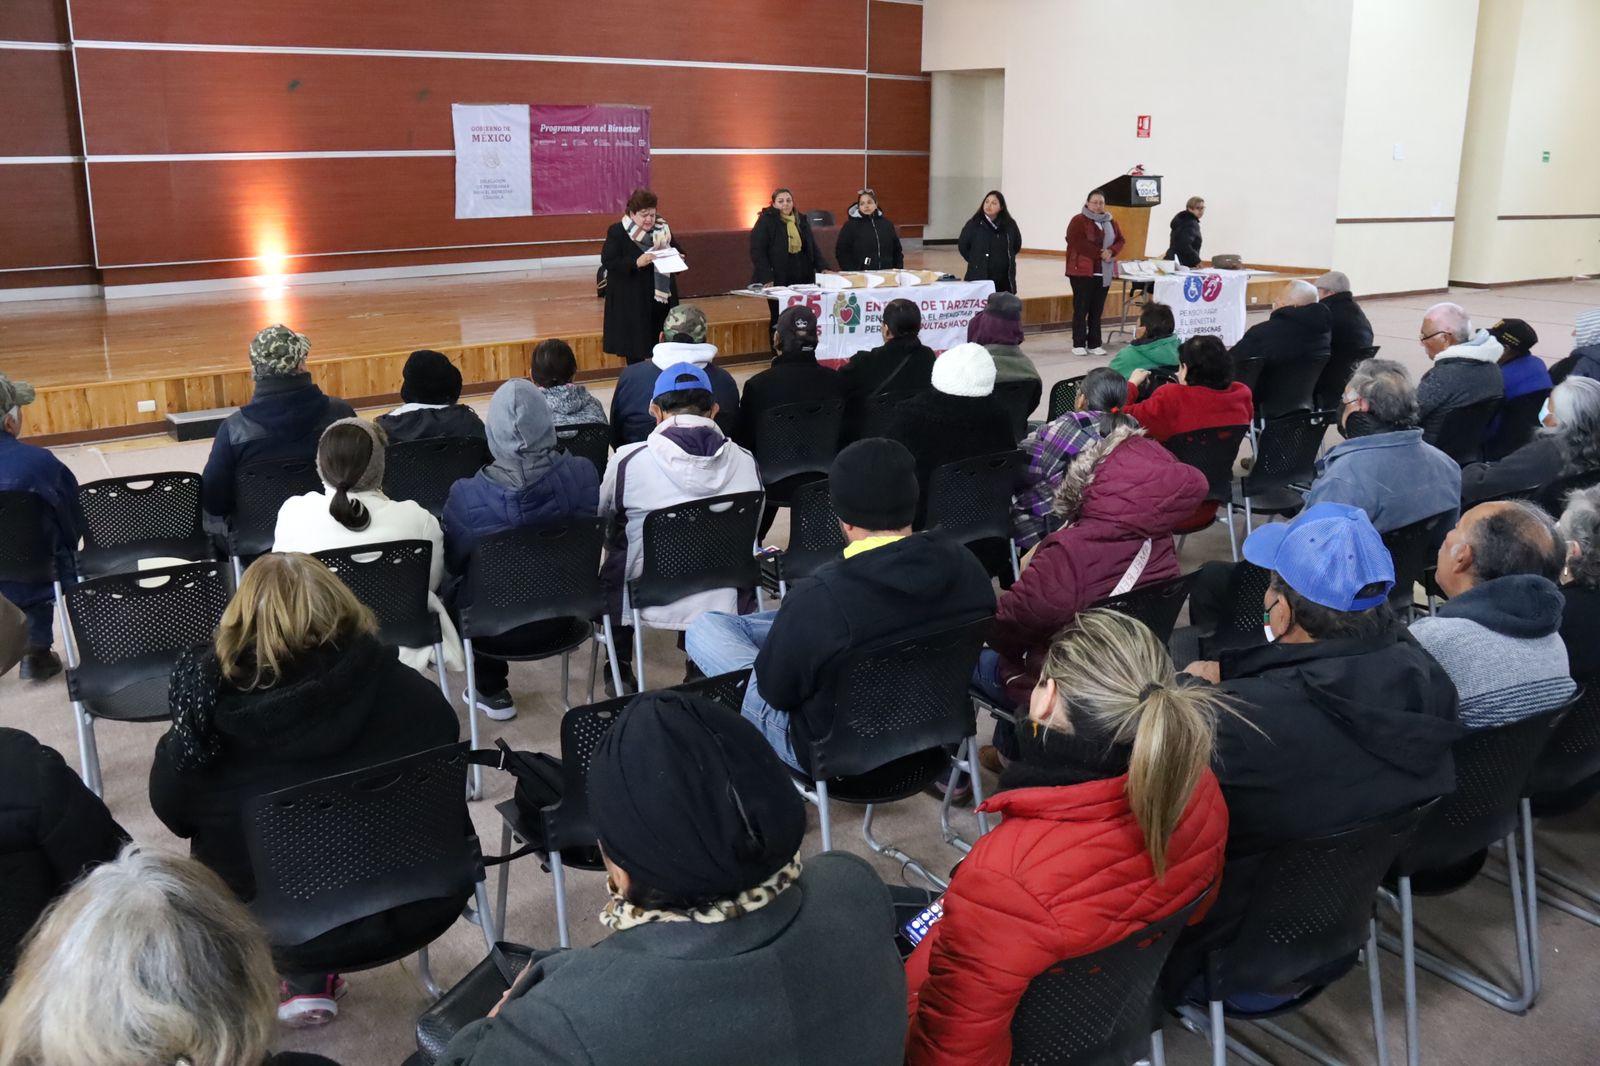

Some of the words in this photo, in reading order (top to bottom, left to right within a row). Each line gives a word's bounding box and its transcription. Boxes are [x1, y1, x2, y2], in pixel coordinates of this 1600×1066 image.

[540, 123, 581, 134] Programas
[581, 124, 599, 134] para
[600, 124, 607, 133] el
[608, 123, 641, 133] Bienestar
[921, 300, 937, 311] DE
[939, 298, 988, 311] TARJETAS
[928, 313, 938, 321] EL
